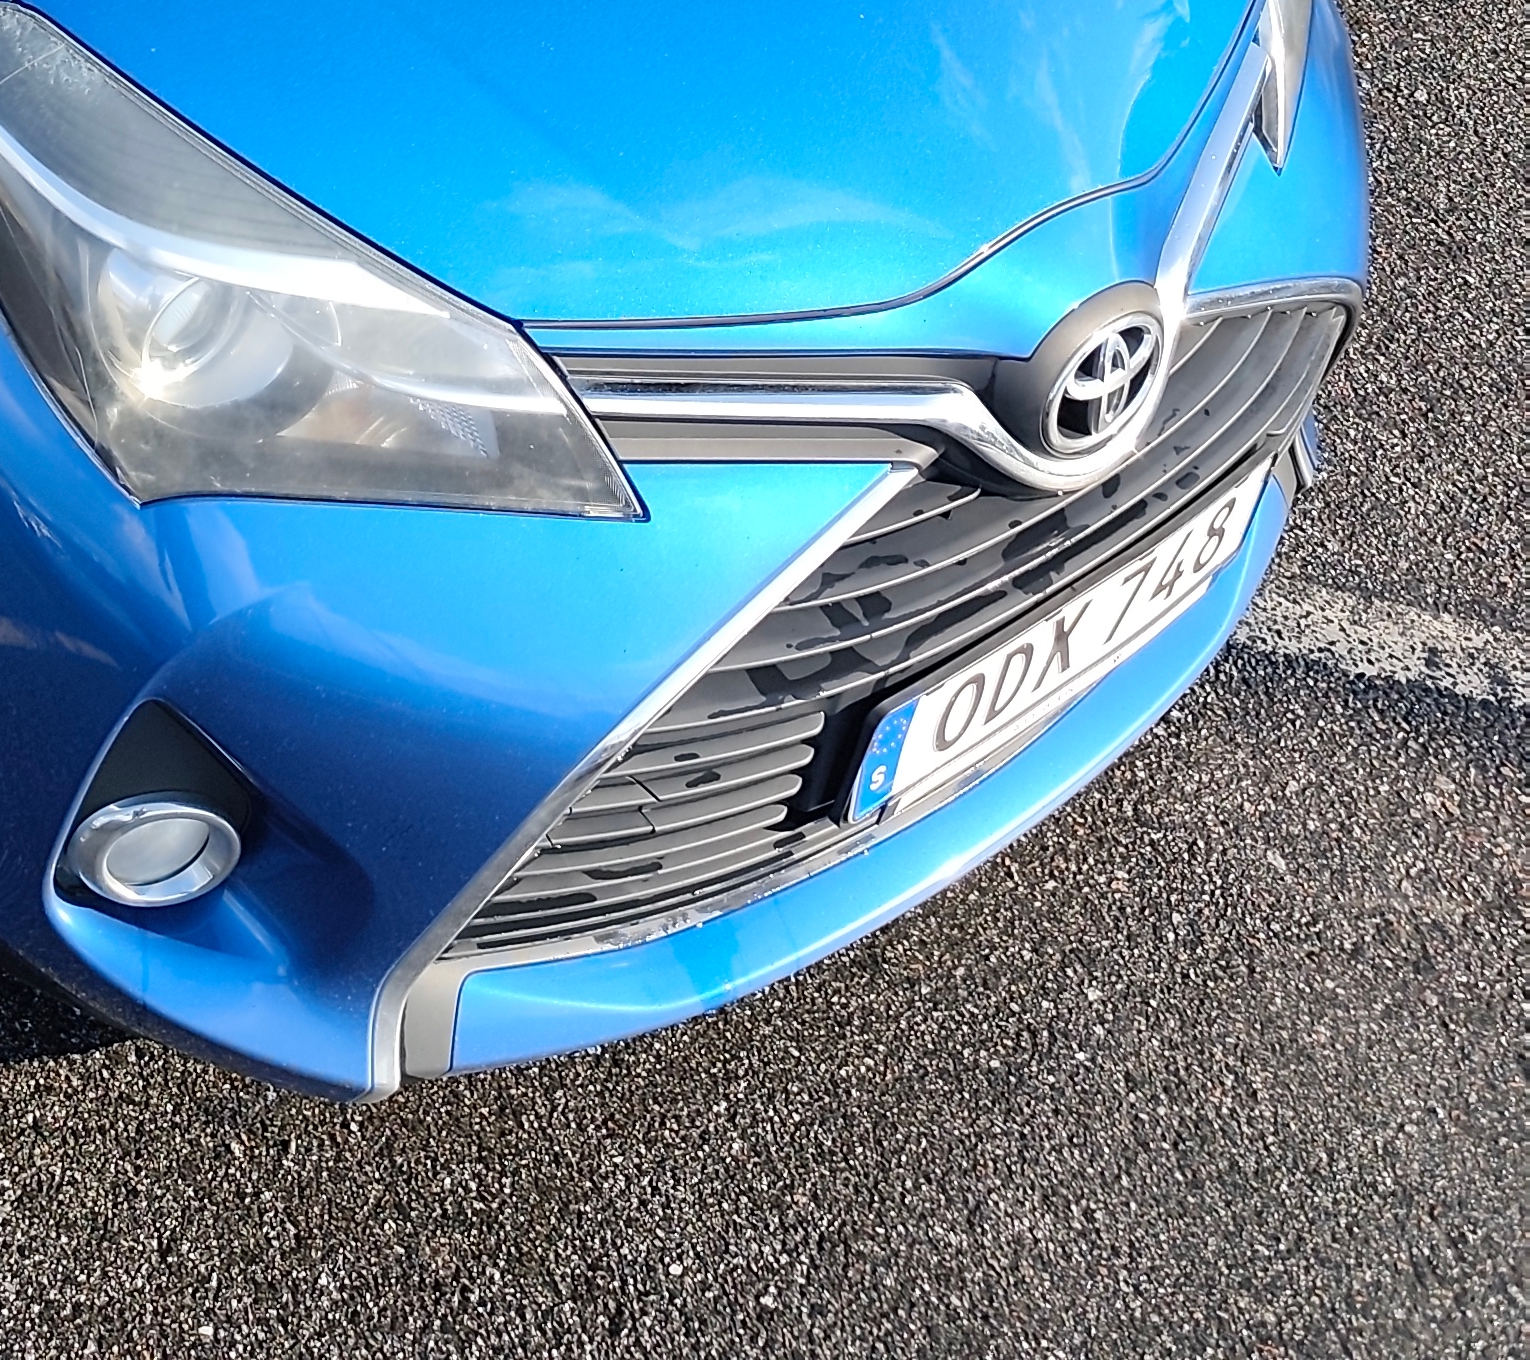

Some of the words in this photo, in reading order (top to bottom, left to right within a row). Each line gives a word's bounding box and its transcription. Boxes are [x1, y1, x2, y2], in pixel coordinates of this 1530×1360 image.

[933, 598, 1094, 752] ODX
[1103, 497, 1238, 646] 748
[869, 765, 887, 791] S
